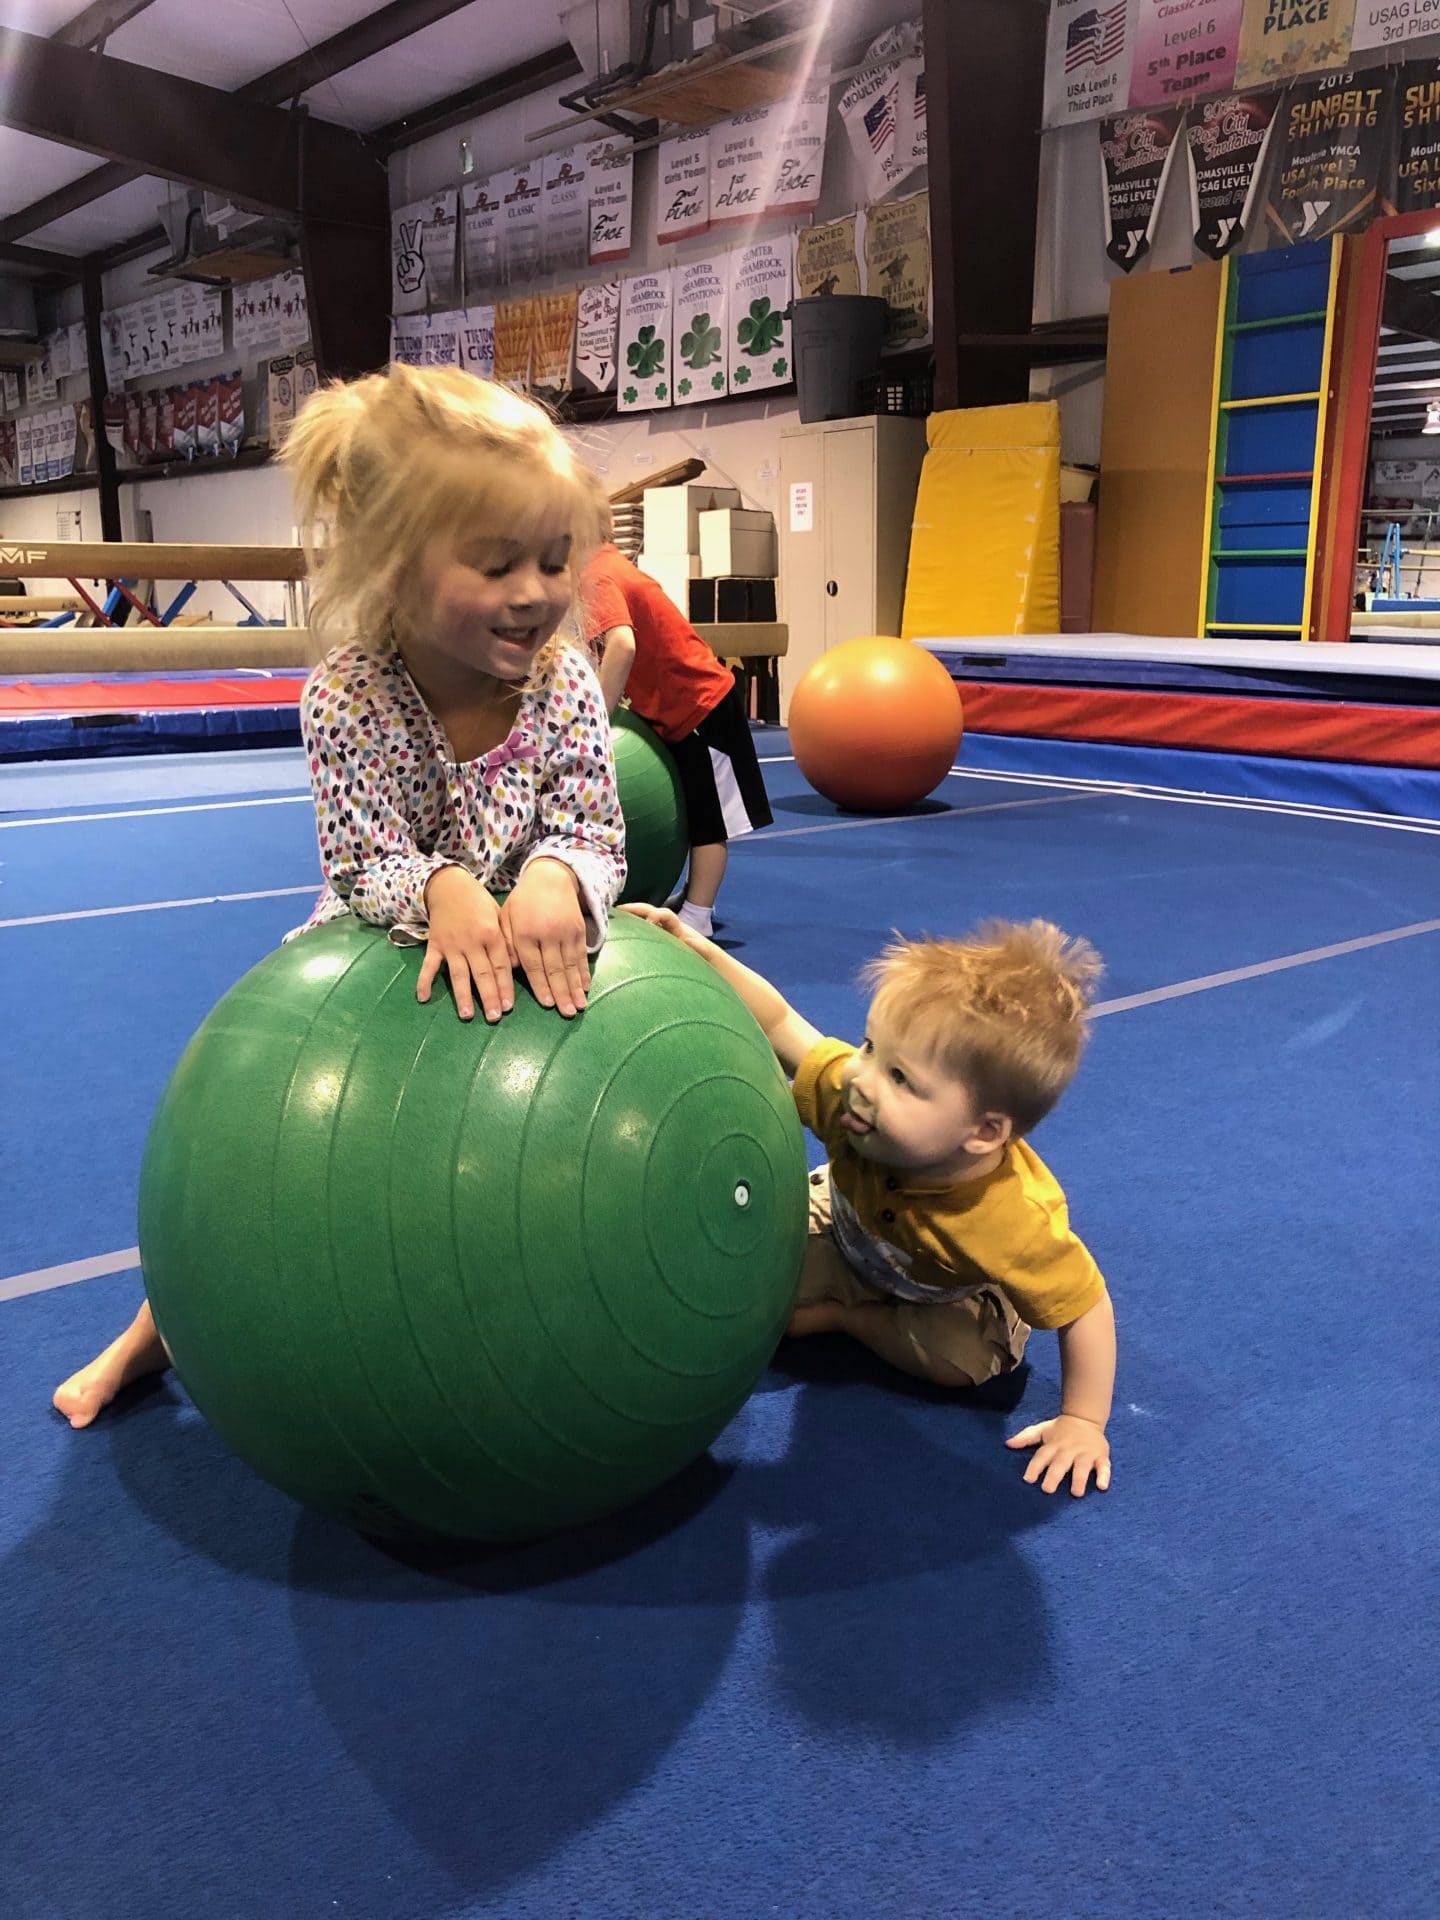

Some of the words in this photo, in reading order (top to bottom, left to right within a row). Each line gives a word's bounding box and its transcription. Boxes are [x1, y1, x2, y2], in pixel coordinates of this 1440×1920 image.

[1158, 1, 1196, 18] Classic
[1264, 1, 1329, 35] PLACE
[1369, 2, 1410, 26] USAG
[1164, 20, 1202, 46] Level
[1207, 19, 1216, 33] 6
[1382, 22, 1404, 41] 3rd
[1408, 17, 1440, 35] Plac
[1148, 57, 1170, 76] 5th
[1176, 46, 1226, 70] Place
[1067, 83, 1086, 97] USA
[1089, 75, 1110, 92] Level
[1112, 73, 1117, 84] 6
[1161, 71, 1210, 93] Team
[1318, 72, 1354, 91] 2013
[1068, 98, 1091, 112] Third
[1093, 92, 1113, 107] Place
[1289, 89, 1383, 126] SUNBELT
[1223, 111, 1250, 136] City
[1287, 110, 1378, 142] SHINDIG
[725, 138, 747, 153] Level
[1330, 145, 1361, 156] YMCA
[671, 156, 692, 169] Level
[737, 151, 763, 163] Team
[684, 167, 705, 179] Team
[1197, 163, 1245, 180] OMASVILLE
[1281, 167, 1306, 185] USA
[1398, 159, 1429, 178] USA
[1109, 178, 1151, 193] OMASVILLE
[1222, 175, 1252, 189] LEVEL
[1323, 176, 1366, 190] Place
[672, 186, 698, 208] 2nd
[715, 187, 760, 208] PLACE
[1110, 193, 1129, 205] SAG
[507, 203, 536, 219] CLASSIC
[664, 200, 704, 222] PLACE
[877, 203, 917, 225] WANTED
[594, 212, 619, 230] 2nd
[807, 226, 844, 246] WANTED
[741, 245, 773, 262] SUMTER
[684, 264, 713, 279] SUMTER
[739, 259, 783, 277] SHAMROCK
[632, 278, 659, 291] SUMTER
[681, 276, 721, 294] SHAMROCK
[735, 268, 787, 290] INVITATIONAL
[630, 290, 666, 304] SHAMROCK
